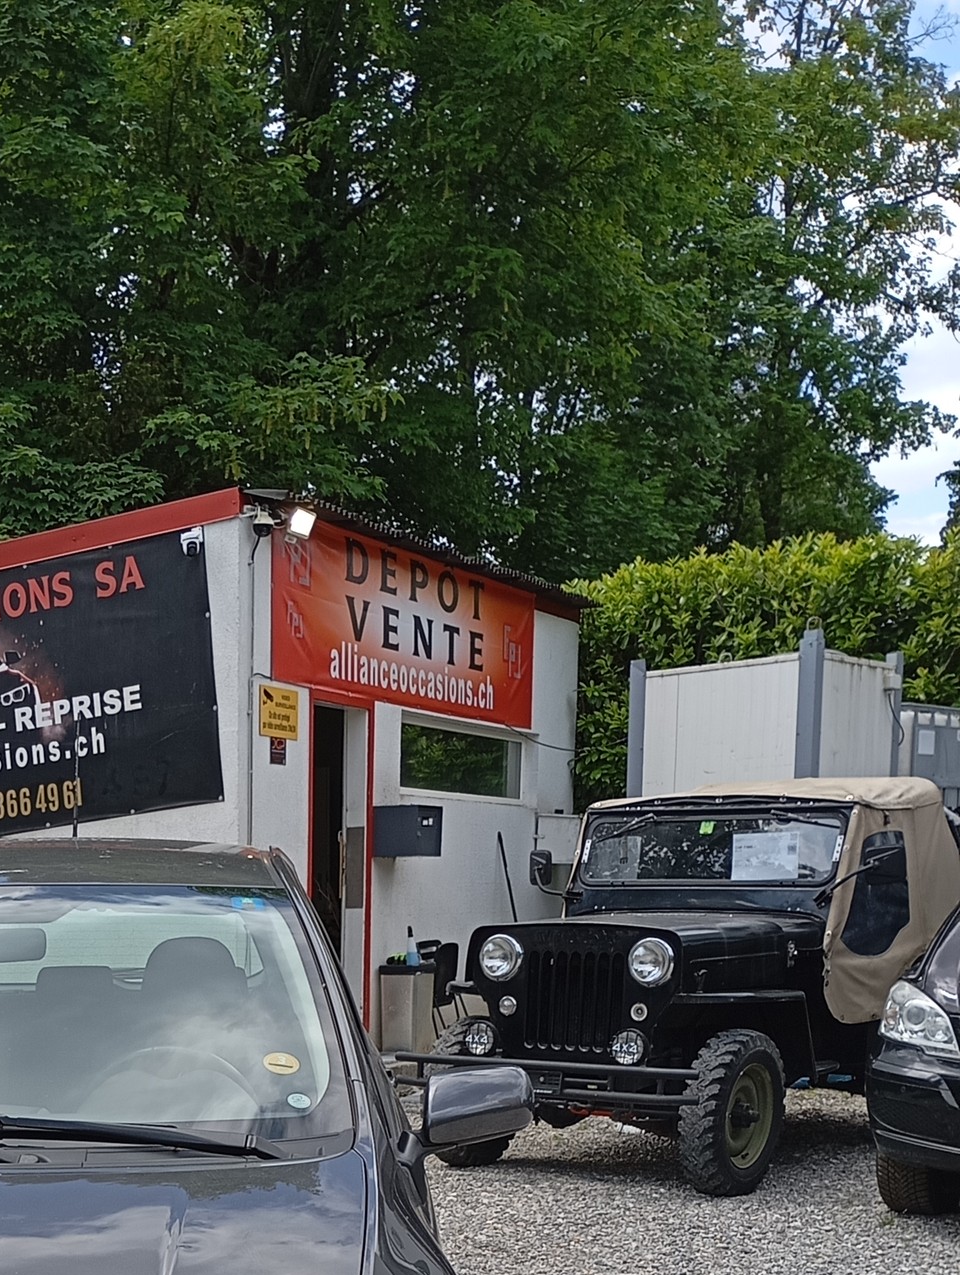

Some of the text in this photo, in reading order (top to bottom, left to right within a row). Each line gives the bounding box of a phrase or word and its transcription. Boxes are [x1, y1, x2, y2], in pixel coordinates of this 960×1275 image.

[94, 555, 146, 598] SA
[345, 594, 485, 673] VENTE
[330, 641, 494, 710] allianceoccasions.ch
[13, 684, 143, 733] REPRISE
[35, 782, 60, 813] 49
